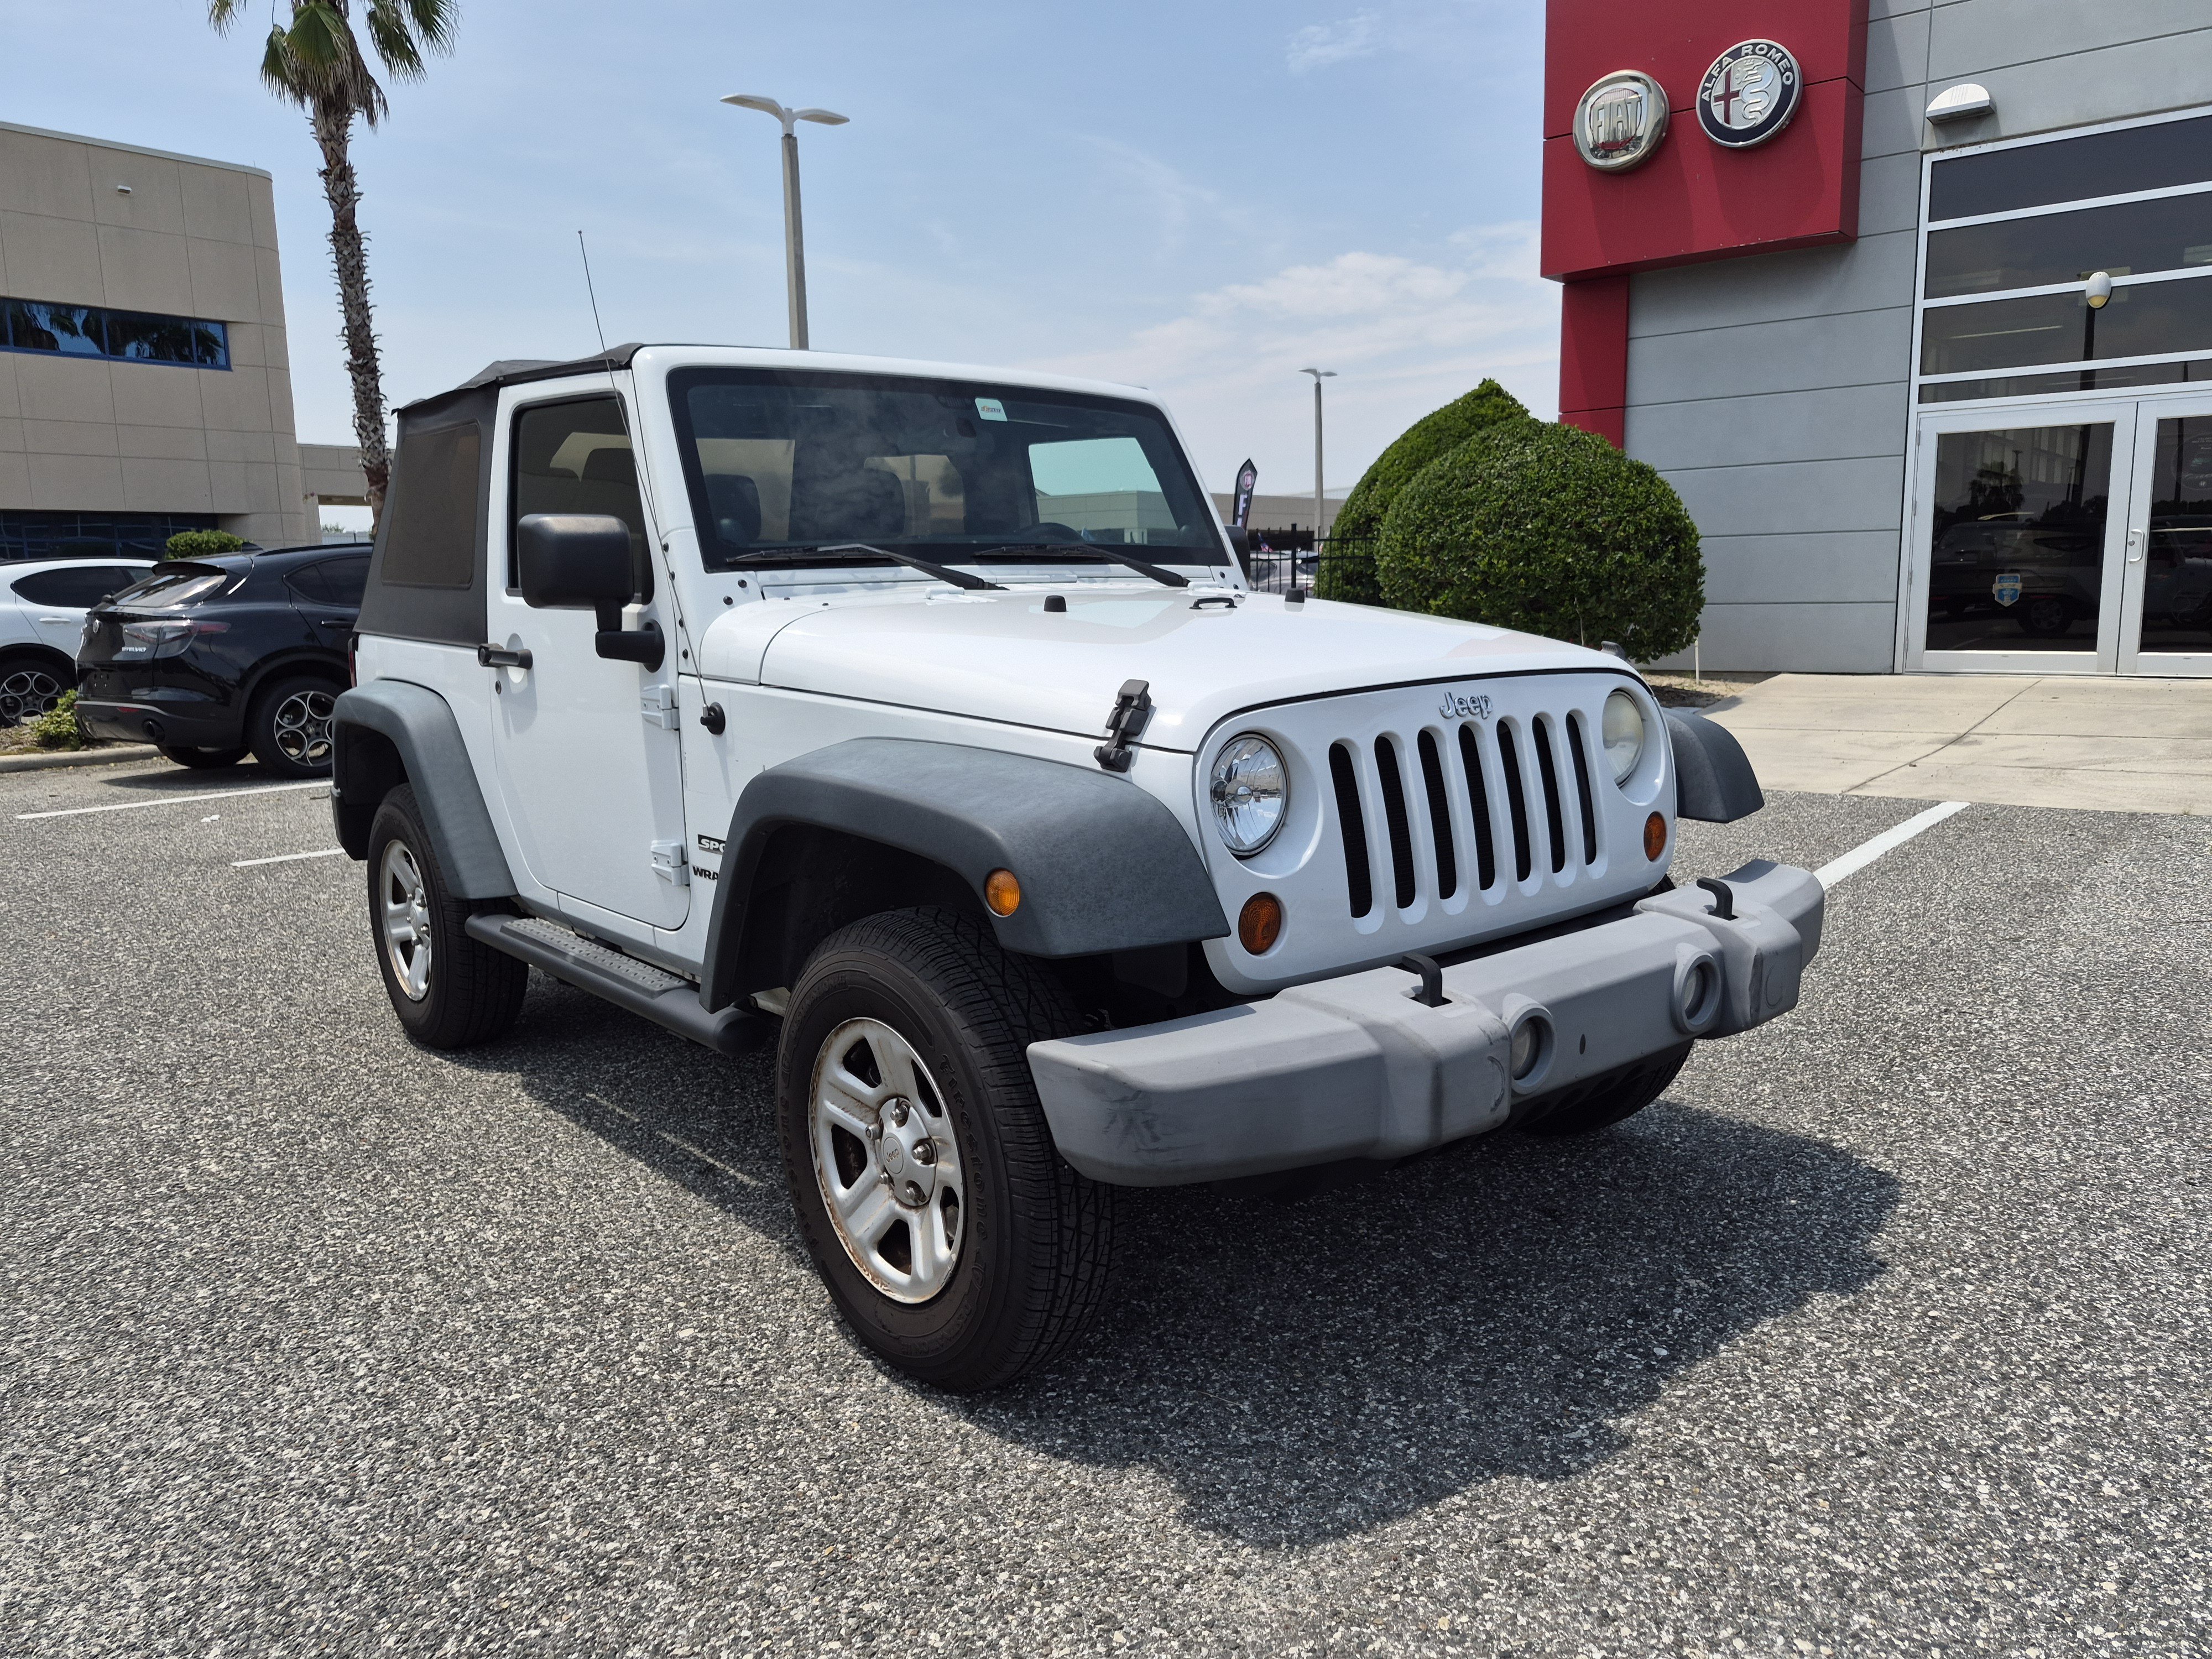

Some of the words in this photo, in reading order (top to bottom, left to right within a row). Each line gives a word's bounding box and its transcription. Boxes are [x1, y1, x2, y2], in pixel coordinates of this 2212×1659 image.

[1701, 56, 1733, 101] ALFA
[1741, 44, 1794, 86] ROMEO
[1592, 95, 1642, 143] FIAT
[1439, 691, 1493, 720] Jeep
[886, 1148, 899, 1163] Jeep
[939, 1053, 988, 1240] Firestone
